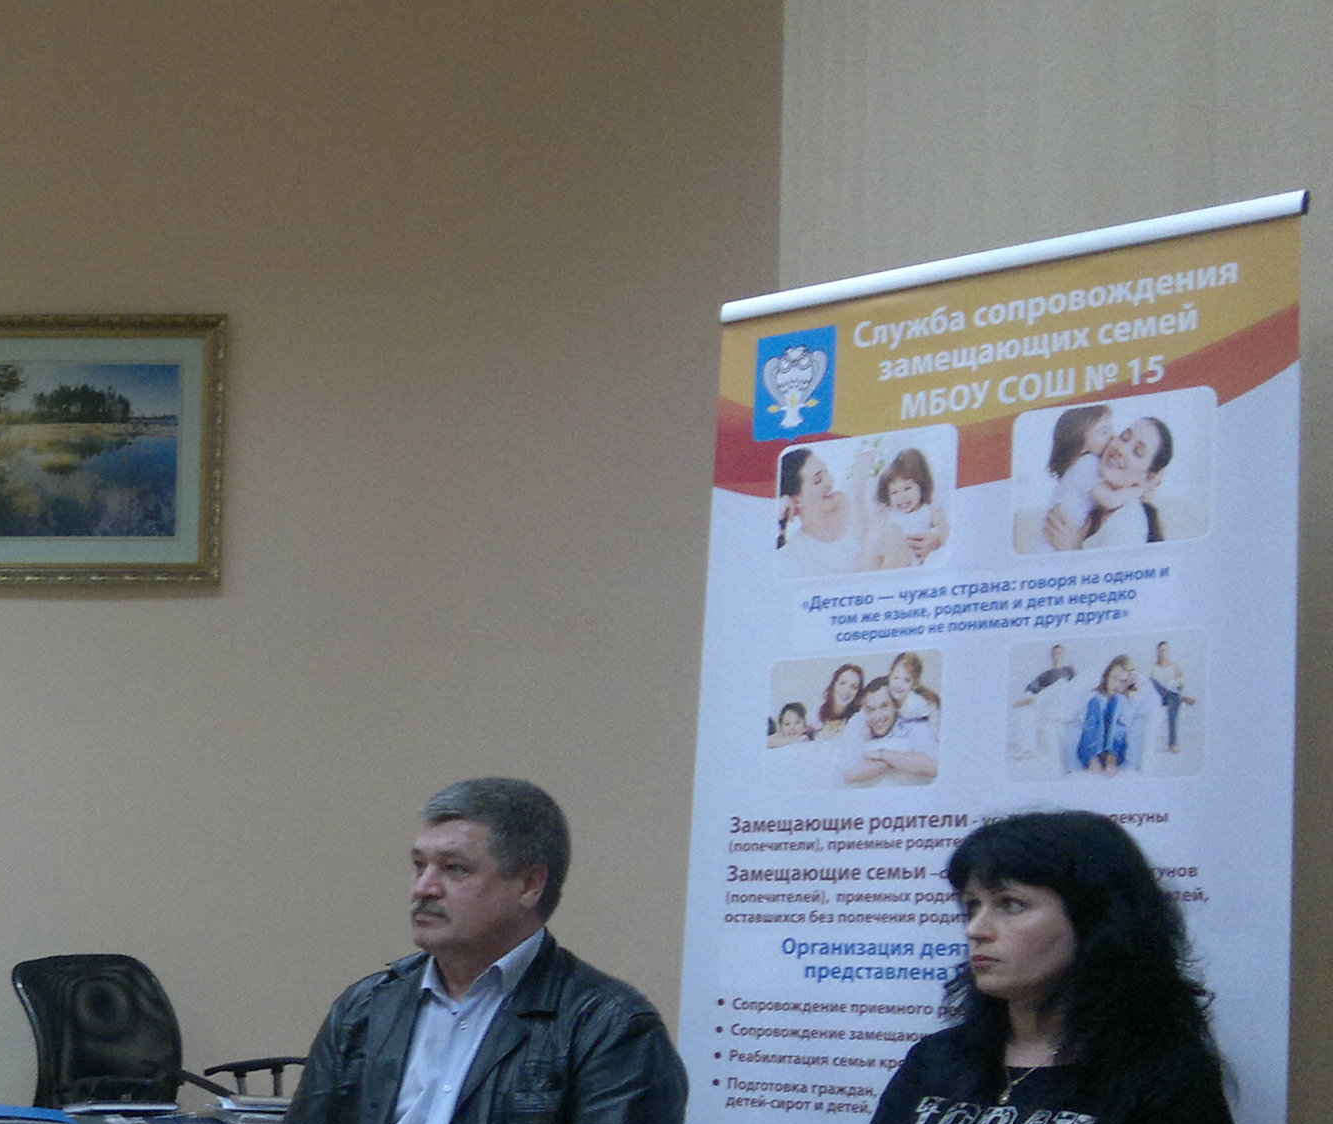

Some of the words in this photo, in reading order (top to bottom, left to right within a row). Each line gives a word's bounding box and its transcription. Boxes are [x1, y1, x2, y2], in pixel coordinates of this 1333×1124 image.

[852, 305, 966, 350] Служба
[973, 261, 1240, 326] сопровождения
[877, 325, 1090, 381] замещающих
[1097, 302, 1200, 345] семей
[899, 380, 992, 420] МБОУ
[997, 366, 1077, 405] СОШ
[1084, 362, 1118, 393] №
[1127, 354, 1166, 386] 15
[899, 586, 947, 605] чужая
[951, 579, 1017, 598] страна:
[1020, 574, 1077, 591] говоря
[1081, 573, 1101, 585] на
[1103, 567, 1157, 583] одном
[1159, 566, 1170, 577] и
[830, 612, 858, 625] том
[860, 611, 880, 622] же
[934, 599, 1009, 619] родители
[1013, 597, 1023, 609] и
[1026, 594, 1065, 610] дети
[1067, 587, 1137, 605] нередко
[836, 625, 925, 643] совершенно
[927, 622, 944, 634] не
[947, 615, 1032, 633] понимают
[1033, 612, 1071, 628] друг
[730, 814, 864, 836] Замещающие
[868, 813, 969, 834] родители
[827, 837, 902, 852] приемные
[727, 864, 861, 884] Замещающие
[866, 865, 927, 881] семьи
[1151, 866, 1199, 881] унов
[836, 890, 912, 905] приемных
[724, 911, 805, 924] оставшихся
[809, 909, 834, 924] без
[838, 911, 915, 925] попечения
[781, 937, 914, 959] Организация
[803, 963, 948, 982] представлена
[732, 997, 847, 1015] Сопровождение
[850, 1002, 933, 1017] приемного
[730, 1023, 846, 1041] Сопровождение
[728, 1049, 829, 1067] Реабилитация
[832, 1055, 876, 1068] семьи
[726, 1077, 808, 1094] Подготовка
[811, 1083, 878, 1099] граждан,
[724, 1095, 810, 1113] детей-сирот
[814, 1100, 824, 1111] и
[827, 1100, 873, 1116] детей,
